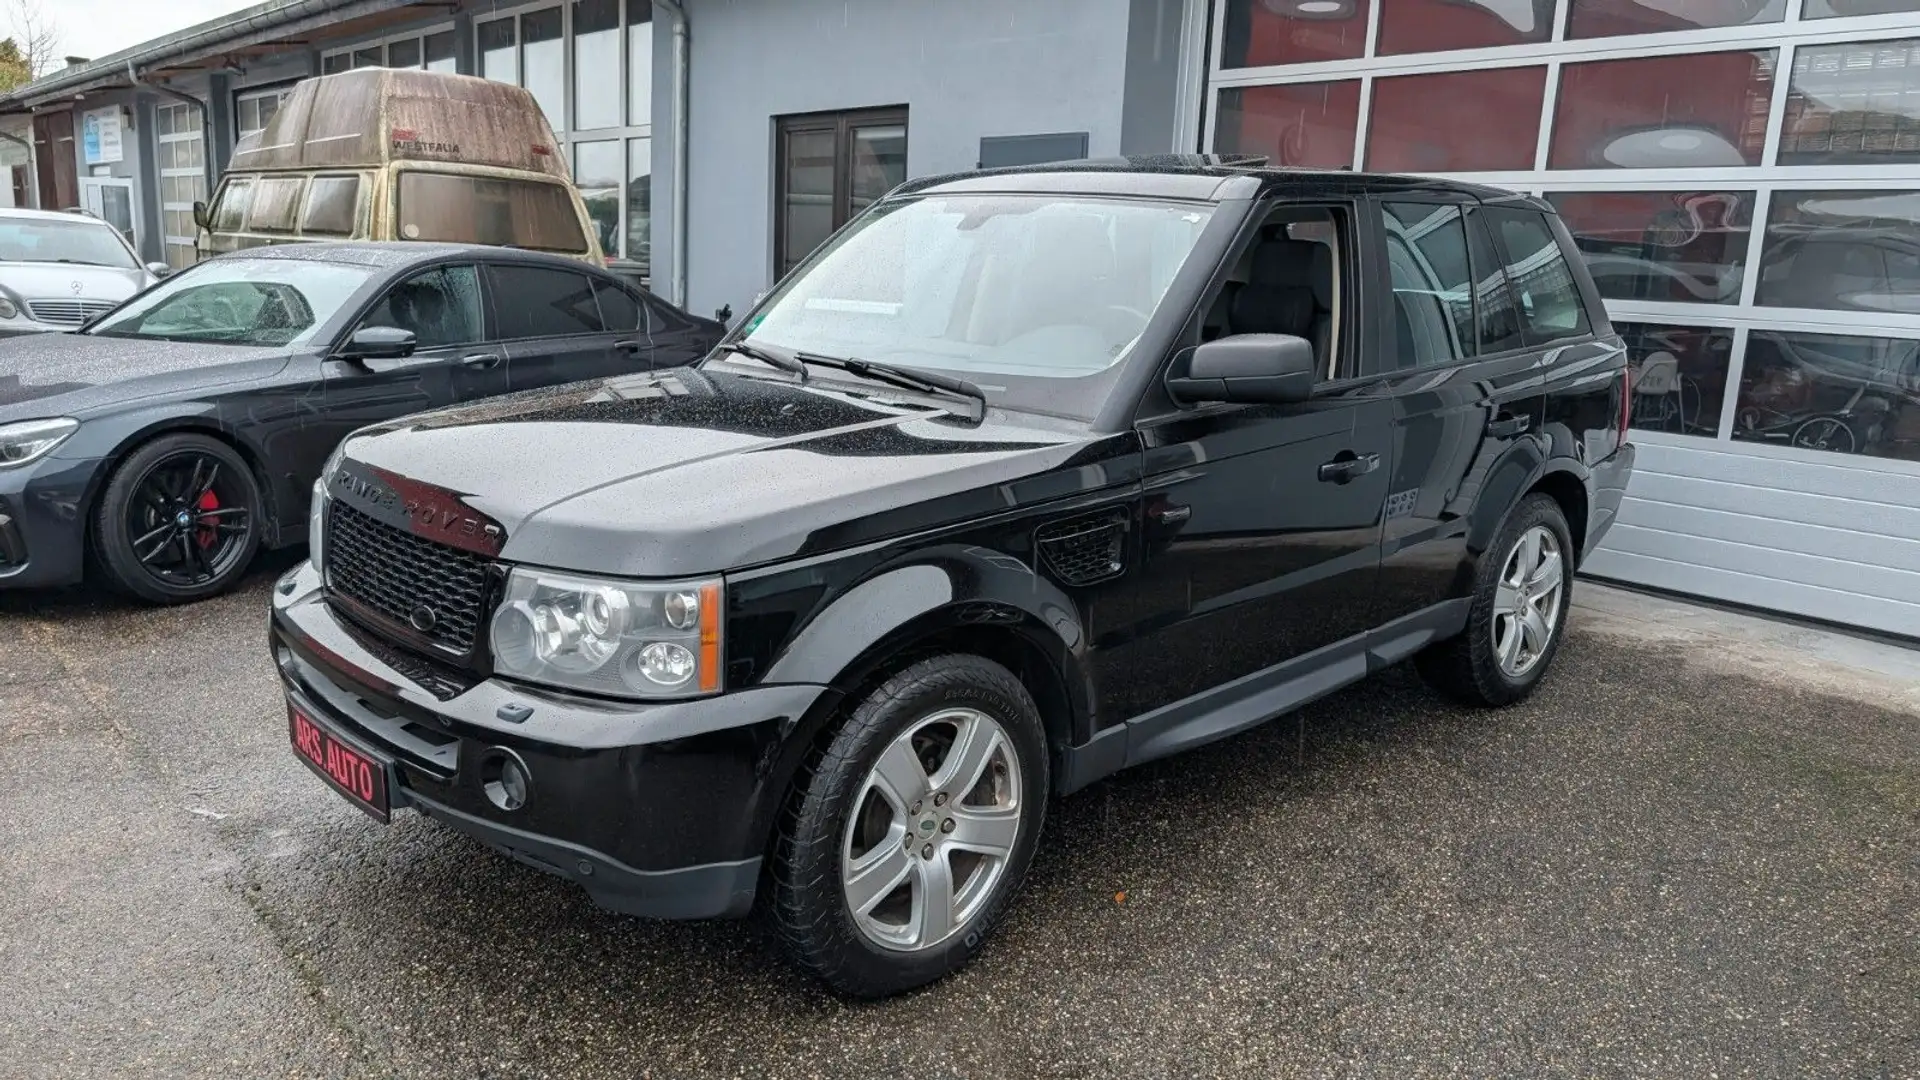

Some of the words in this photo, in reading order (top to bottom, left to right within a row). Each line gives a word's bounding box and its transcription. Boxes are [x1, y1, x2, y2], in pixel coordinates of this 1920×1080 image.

[393, 140, 460, 153] WESTFALIA
[337, 470, 396, 510] RANGE
[402, 499, 501, 542] ROVER
[327, 739, 373, 801] AUTO
